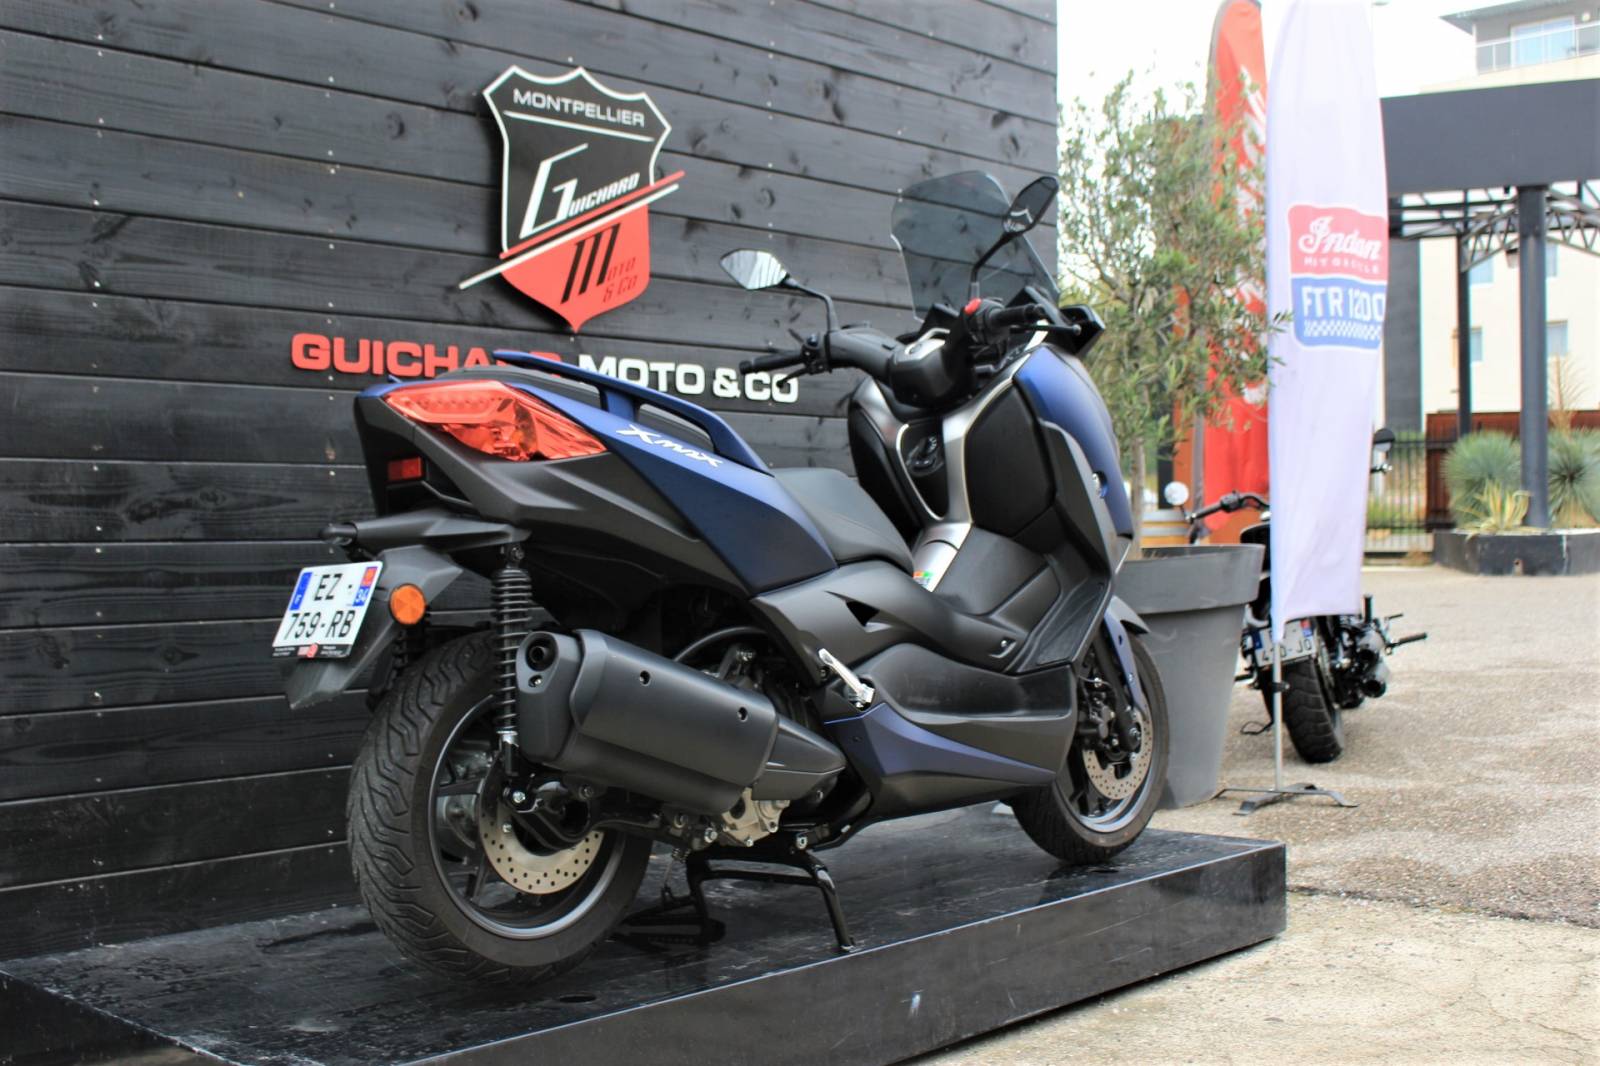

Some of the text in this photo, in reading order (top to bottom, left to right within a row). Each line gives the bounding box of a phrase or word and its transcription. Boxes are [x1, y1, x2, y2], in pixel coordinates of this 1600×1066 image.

[513, 88, 645, 128] MONTPELLIER
[1301, 285, 1343, 318] FTR
[291, 332, 561, 379] GUICHA
[284, 609, 356, 640] 759-RB
